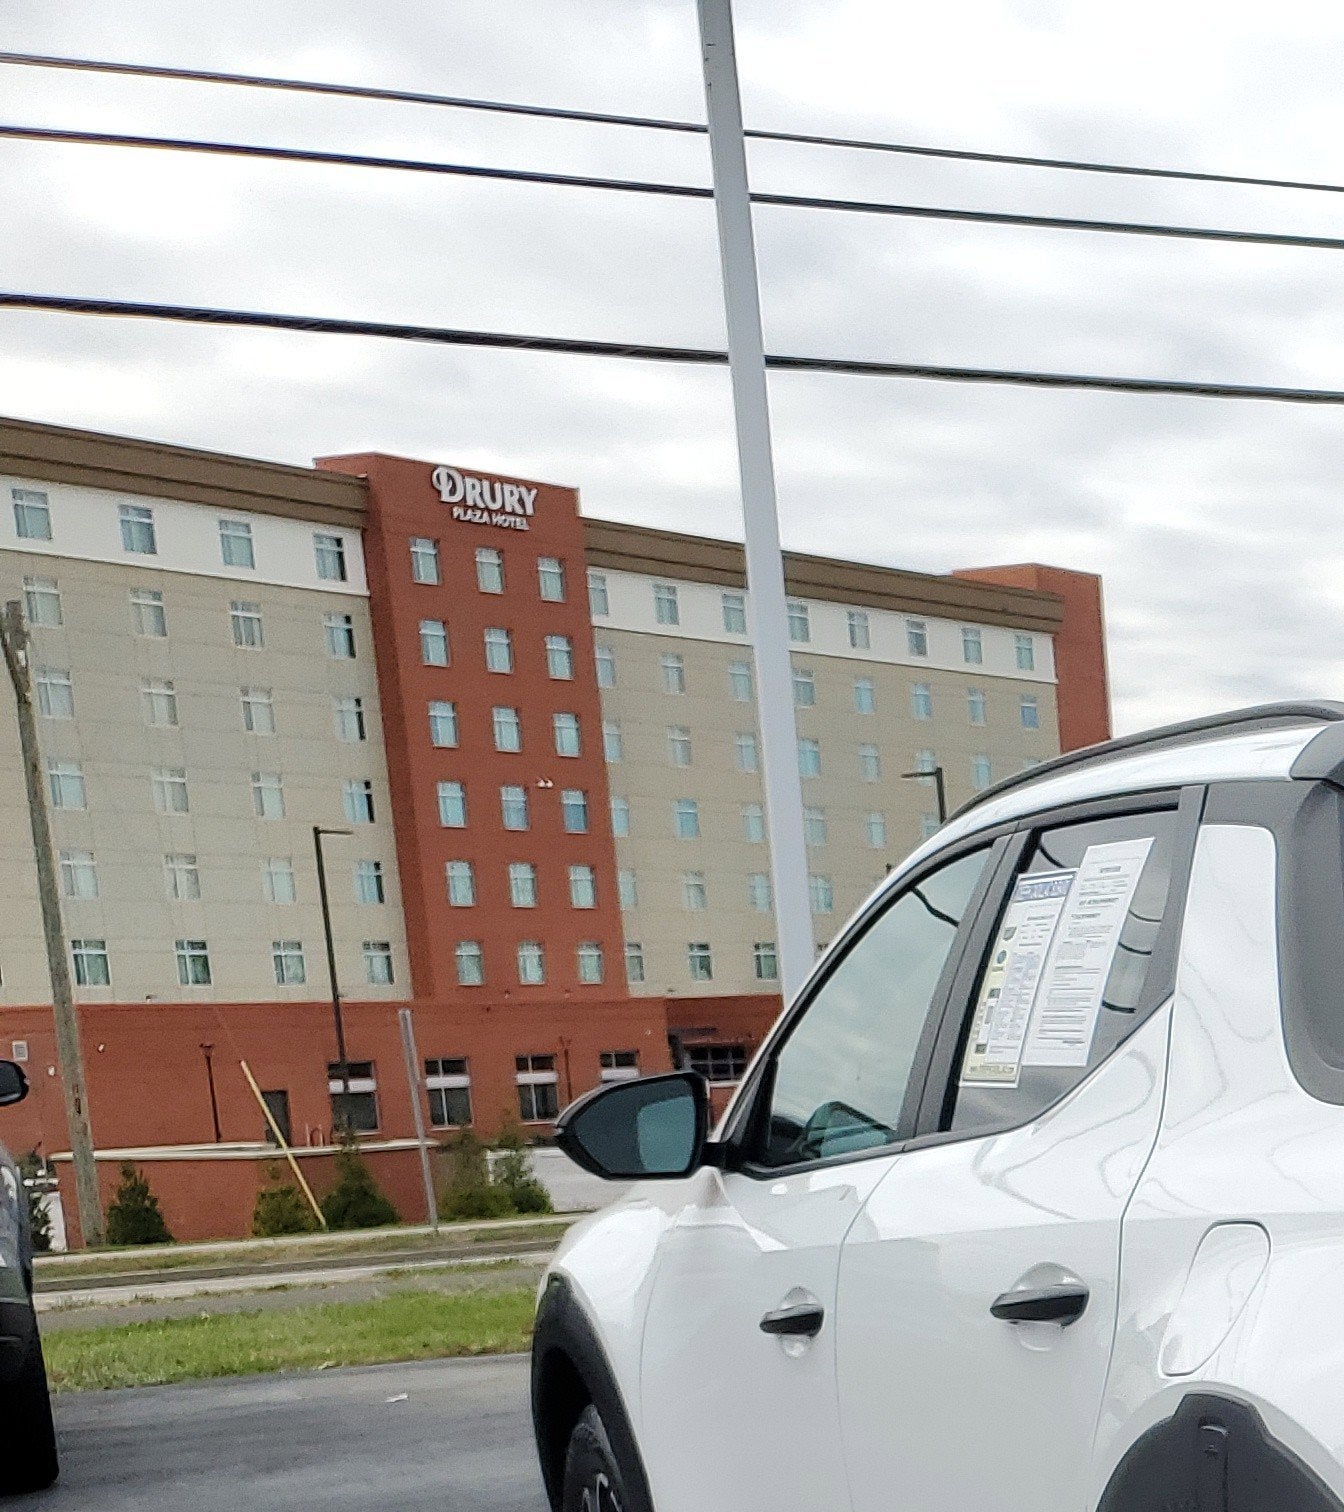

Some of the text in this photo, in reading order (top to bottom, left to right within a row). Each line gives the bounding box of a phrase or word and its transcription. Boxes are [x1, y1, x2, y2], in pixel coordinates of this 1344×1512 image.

[431, 465, 538, 516] DRURY
[452, 505, 530, 531] PLAZA HOTEL
